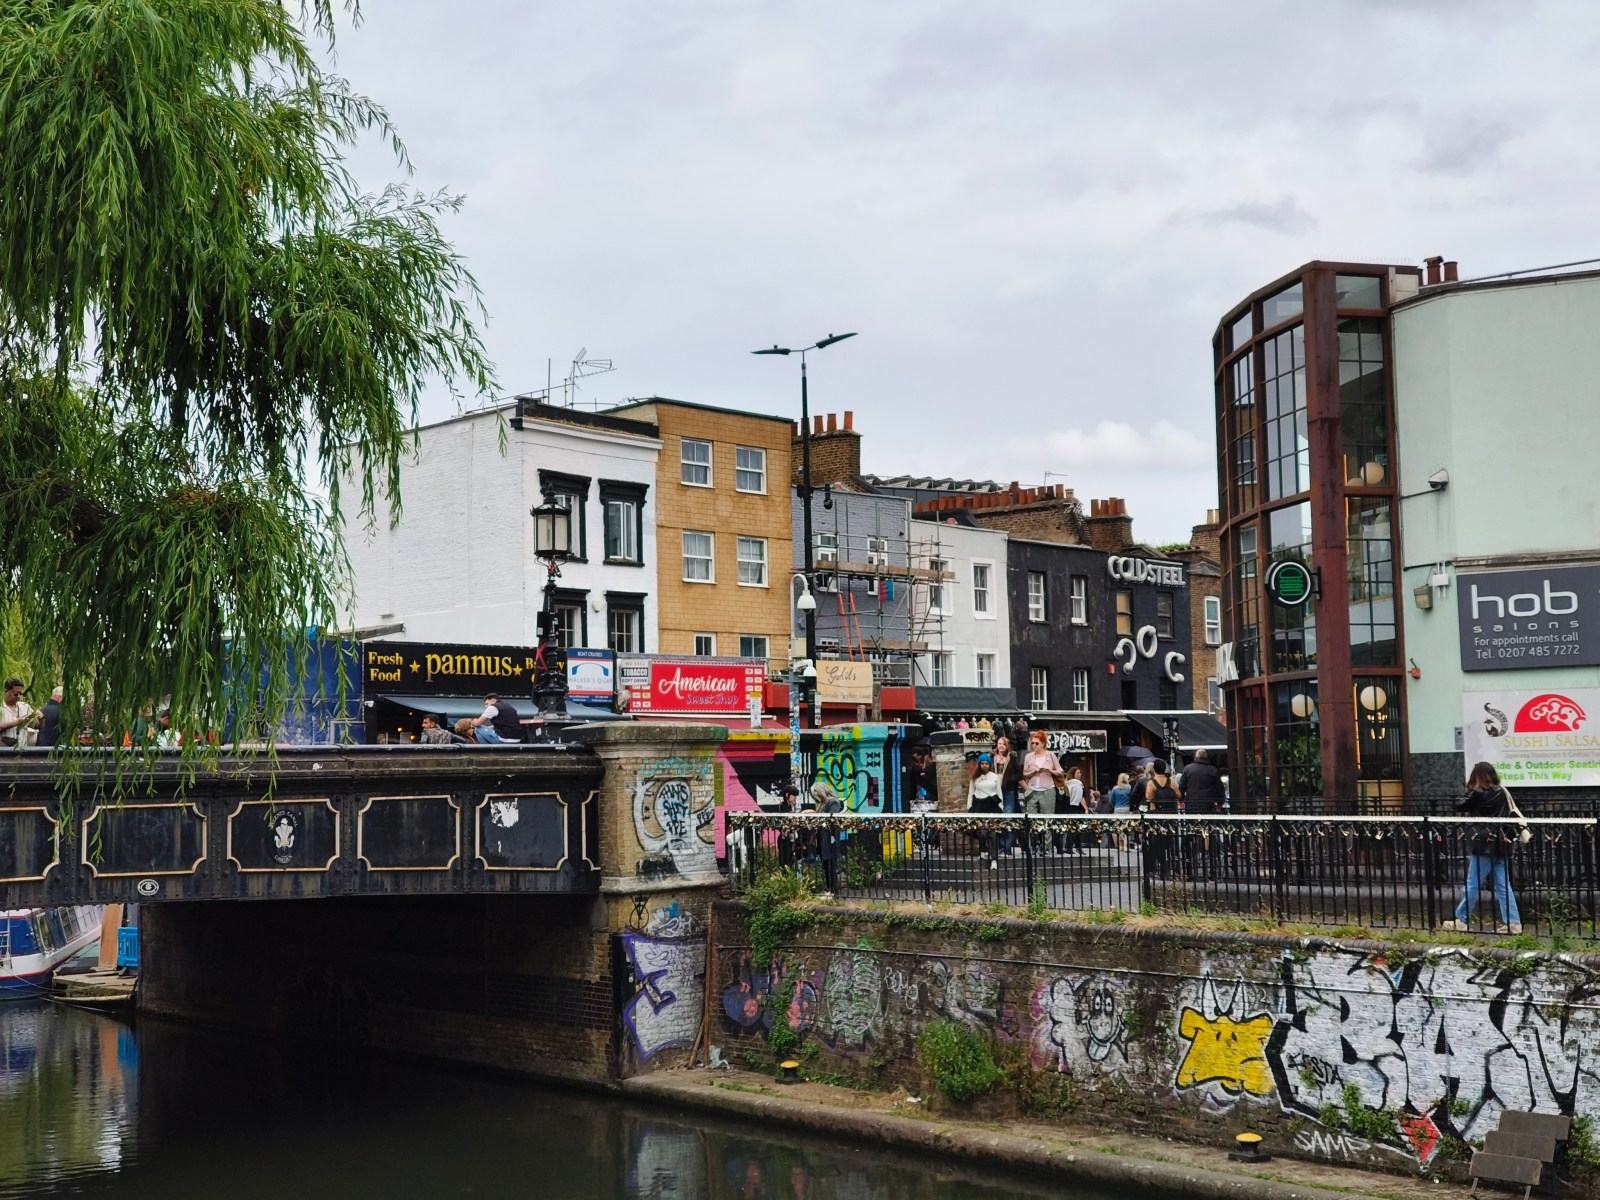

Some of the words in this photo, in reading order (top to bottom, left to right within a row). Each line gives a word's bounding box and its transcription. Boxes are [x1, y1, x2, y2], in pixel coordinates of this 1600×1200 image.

[1471, 580, 1578, 619] hob
[1473, 620, 1580, 633] salons
[1474, 637, 1490, 646] For
[1492, 634, 1559, 647] appointments
[1561, 632, 1579, 641] call
[1476, 649, 1495, 659] Tel.
[1498, 647, 1526, 658] 0207
[1529, 646, 1550, 656] 485
[1553, 645, 1580, 655] 7272
[368, 651, 403, 666] Fresh
[425, 653, 513, 683] pannus
[623, 668, 648, 676] TOBACCO
[370, 668, 401, 681] Food
[659, 667, 737, 699] American
[687, 694, 714, 705] Sweet
[716, 693, 738, 708] Shop
[1504, 735, 1549, 748] SUSHI
[1555, 735, 1600, 747] SALSA
[1515, 761, 1522, 769] &
[1526, 761, 1566, 769] Outdoor
[1569, 760, 1600, 769] Seatin
[1528, 771, 1549, 780] This
[1552, 771, 1573, 781] Way
